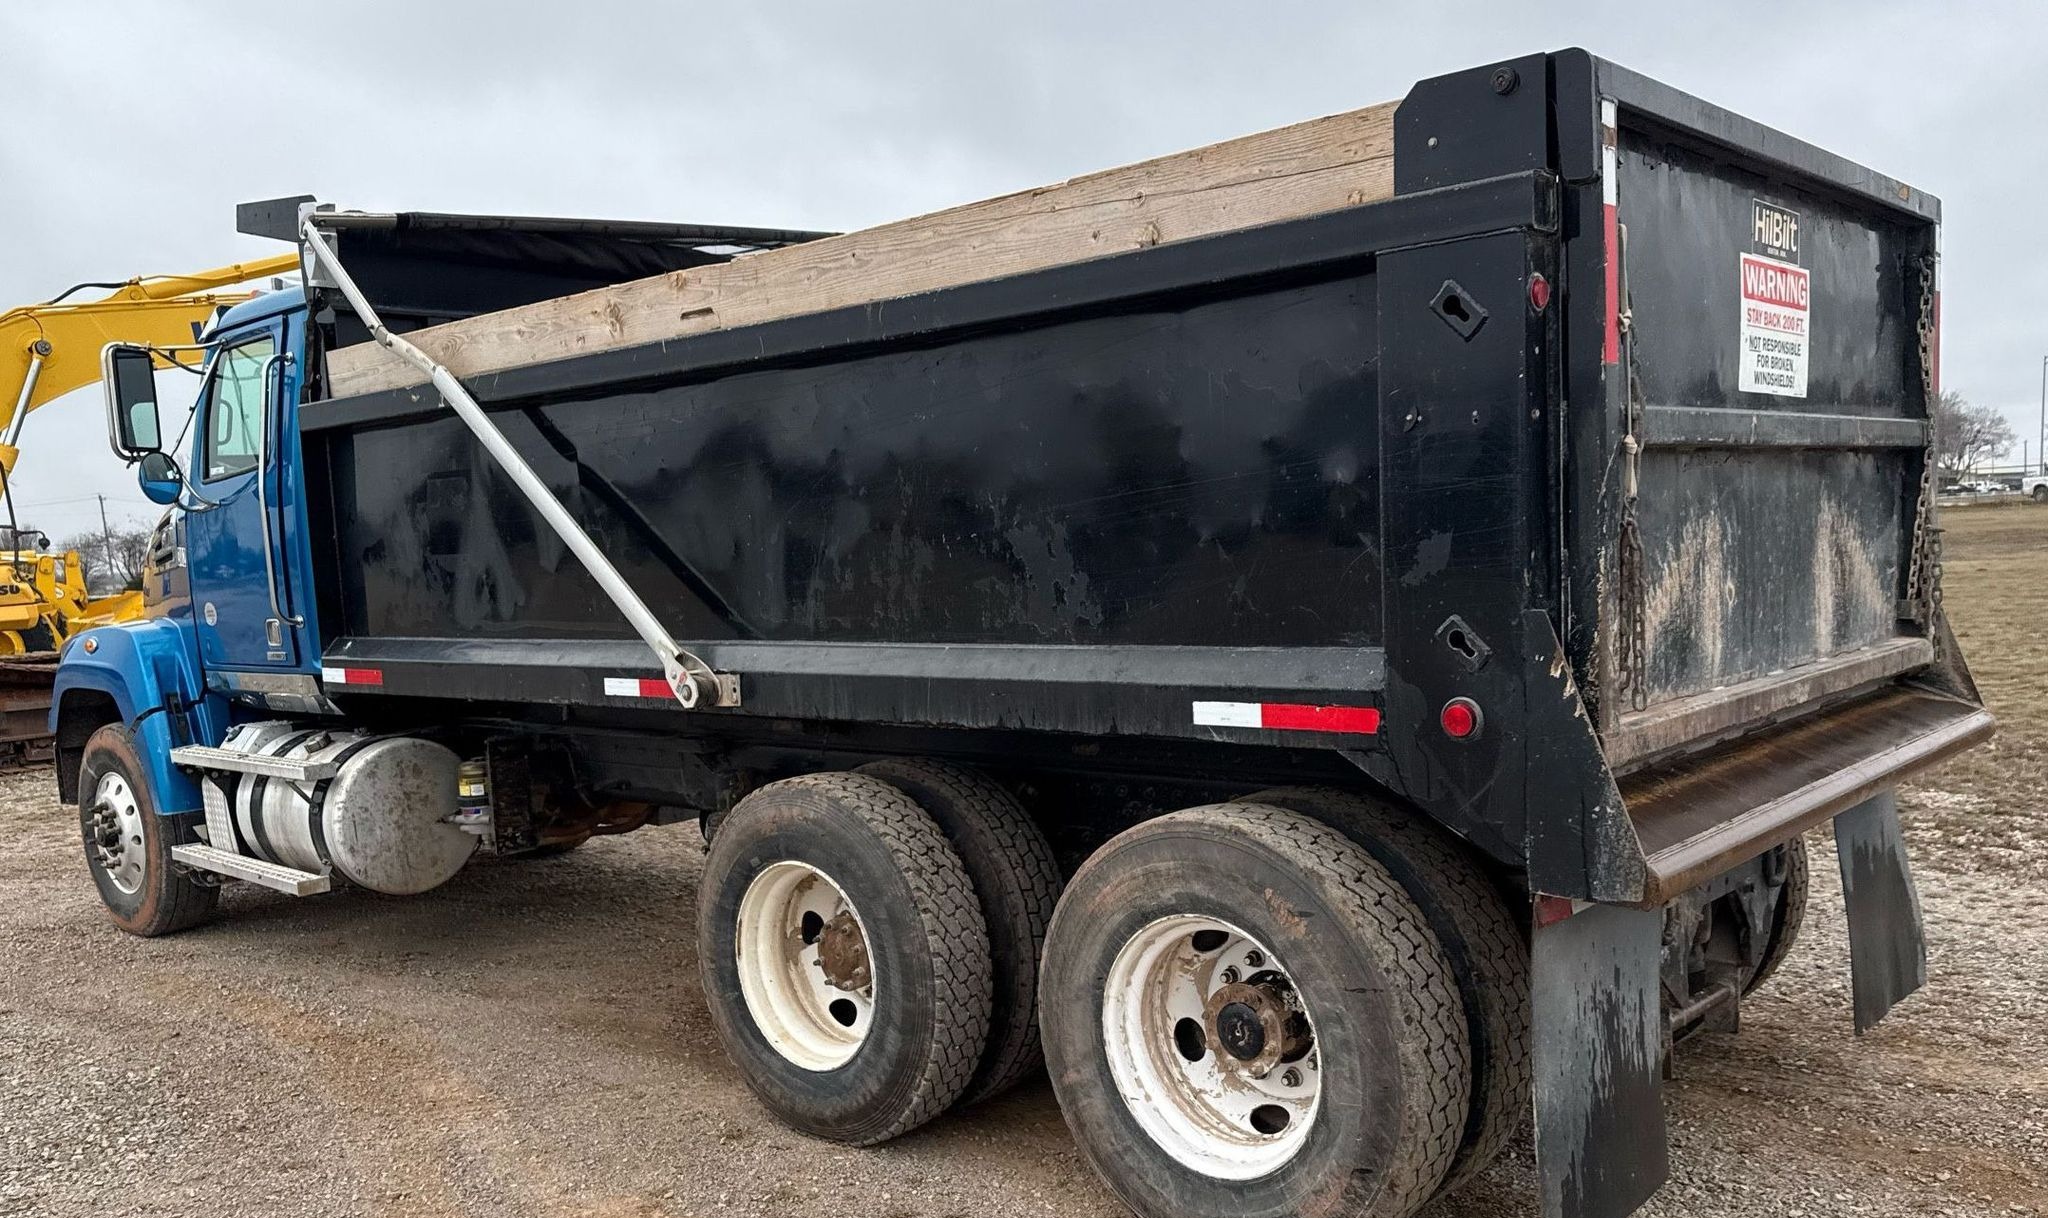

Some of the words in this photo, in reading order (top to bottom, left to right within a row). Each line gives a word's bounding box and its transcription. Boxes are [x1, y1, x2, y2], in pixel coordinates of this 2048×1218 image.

[1755, 206, 1797, 252] HilBilt
[1744, 263, 1807, 306] WARNING
[1747, 308, 1763, 325] STAY
[1764, 311, 1781, 328] BACK
[1783, 314, 1795, 331] 200
[1749, 335, 1761, 350] NOT
[1763, 337, 1801, 356] RESPONSIBLE
[1757, 354, 1770, 368] FOR
[1771, 356, 1793, 372] BROKEN
[1754, 371, 1795, 388] WINDSHIELDS!
